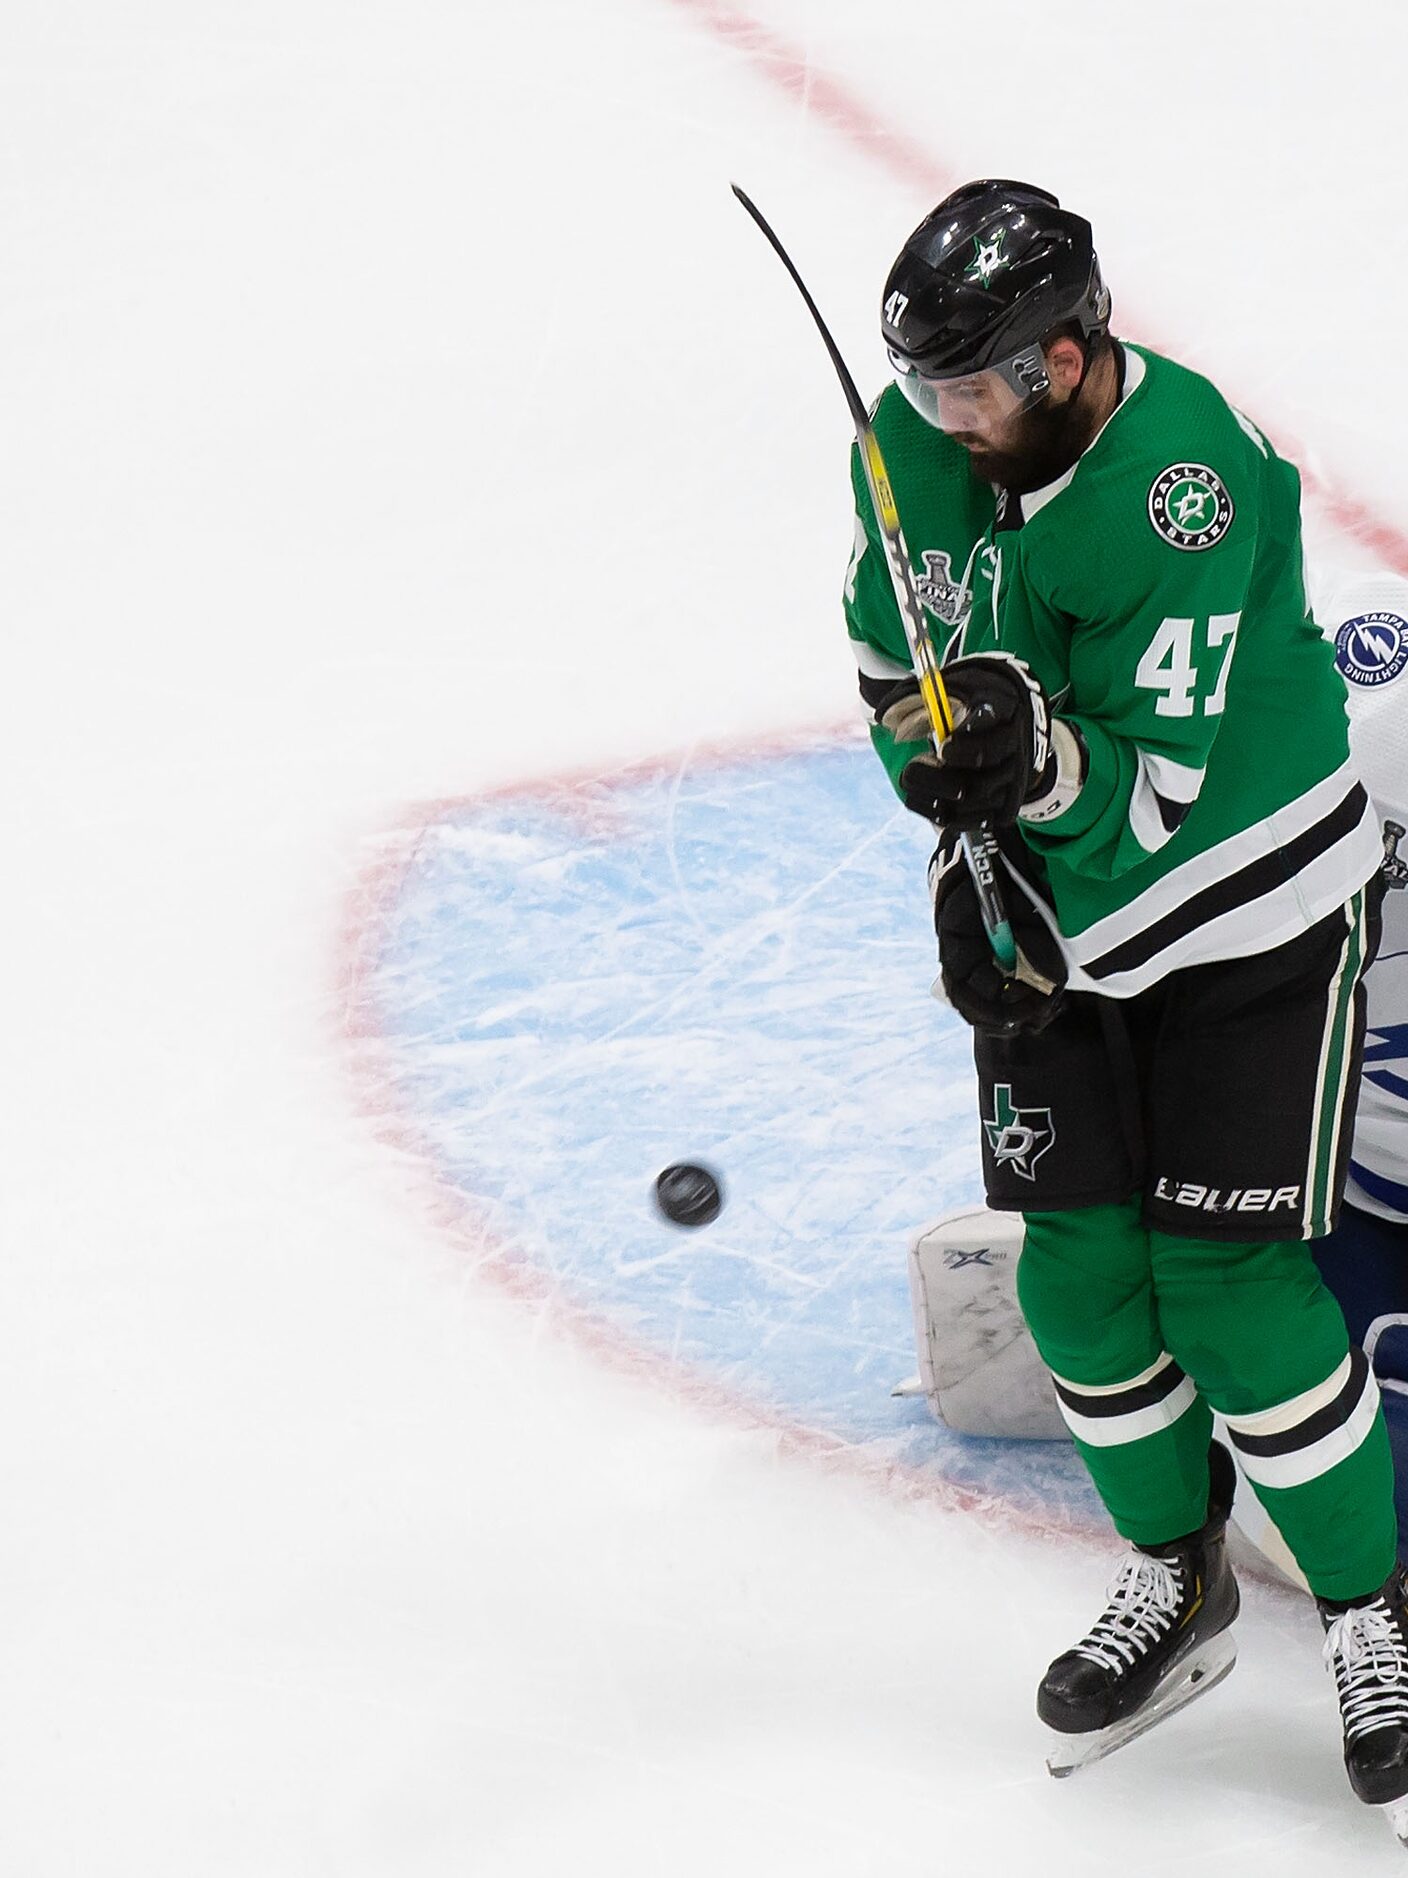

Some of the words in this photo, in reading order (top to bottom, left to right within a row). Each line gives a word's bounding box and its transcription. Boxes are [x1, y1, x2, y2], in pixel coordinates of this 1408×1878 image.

[884, 289, 909, 328] 47
[1153, 467, 1221, 510] DALLAS
[1166, 510, 1228, 545] STARS
[917, 580, 969, 602] INA
[1363, 613, 1404, 629] TAMPA
[1134, 609, 1242, 718] 47
[1343, 651, 1408, 683] LIGHTNING
